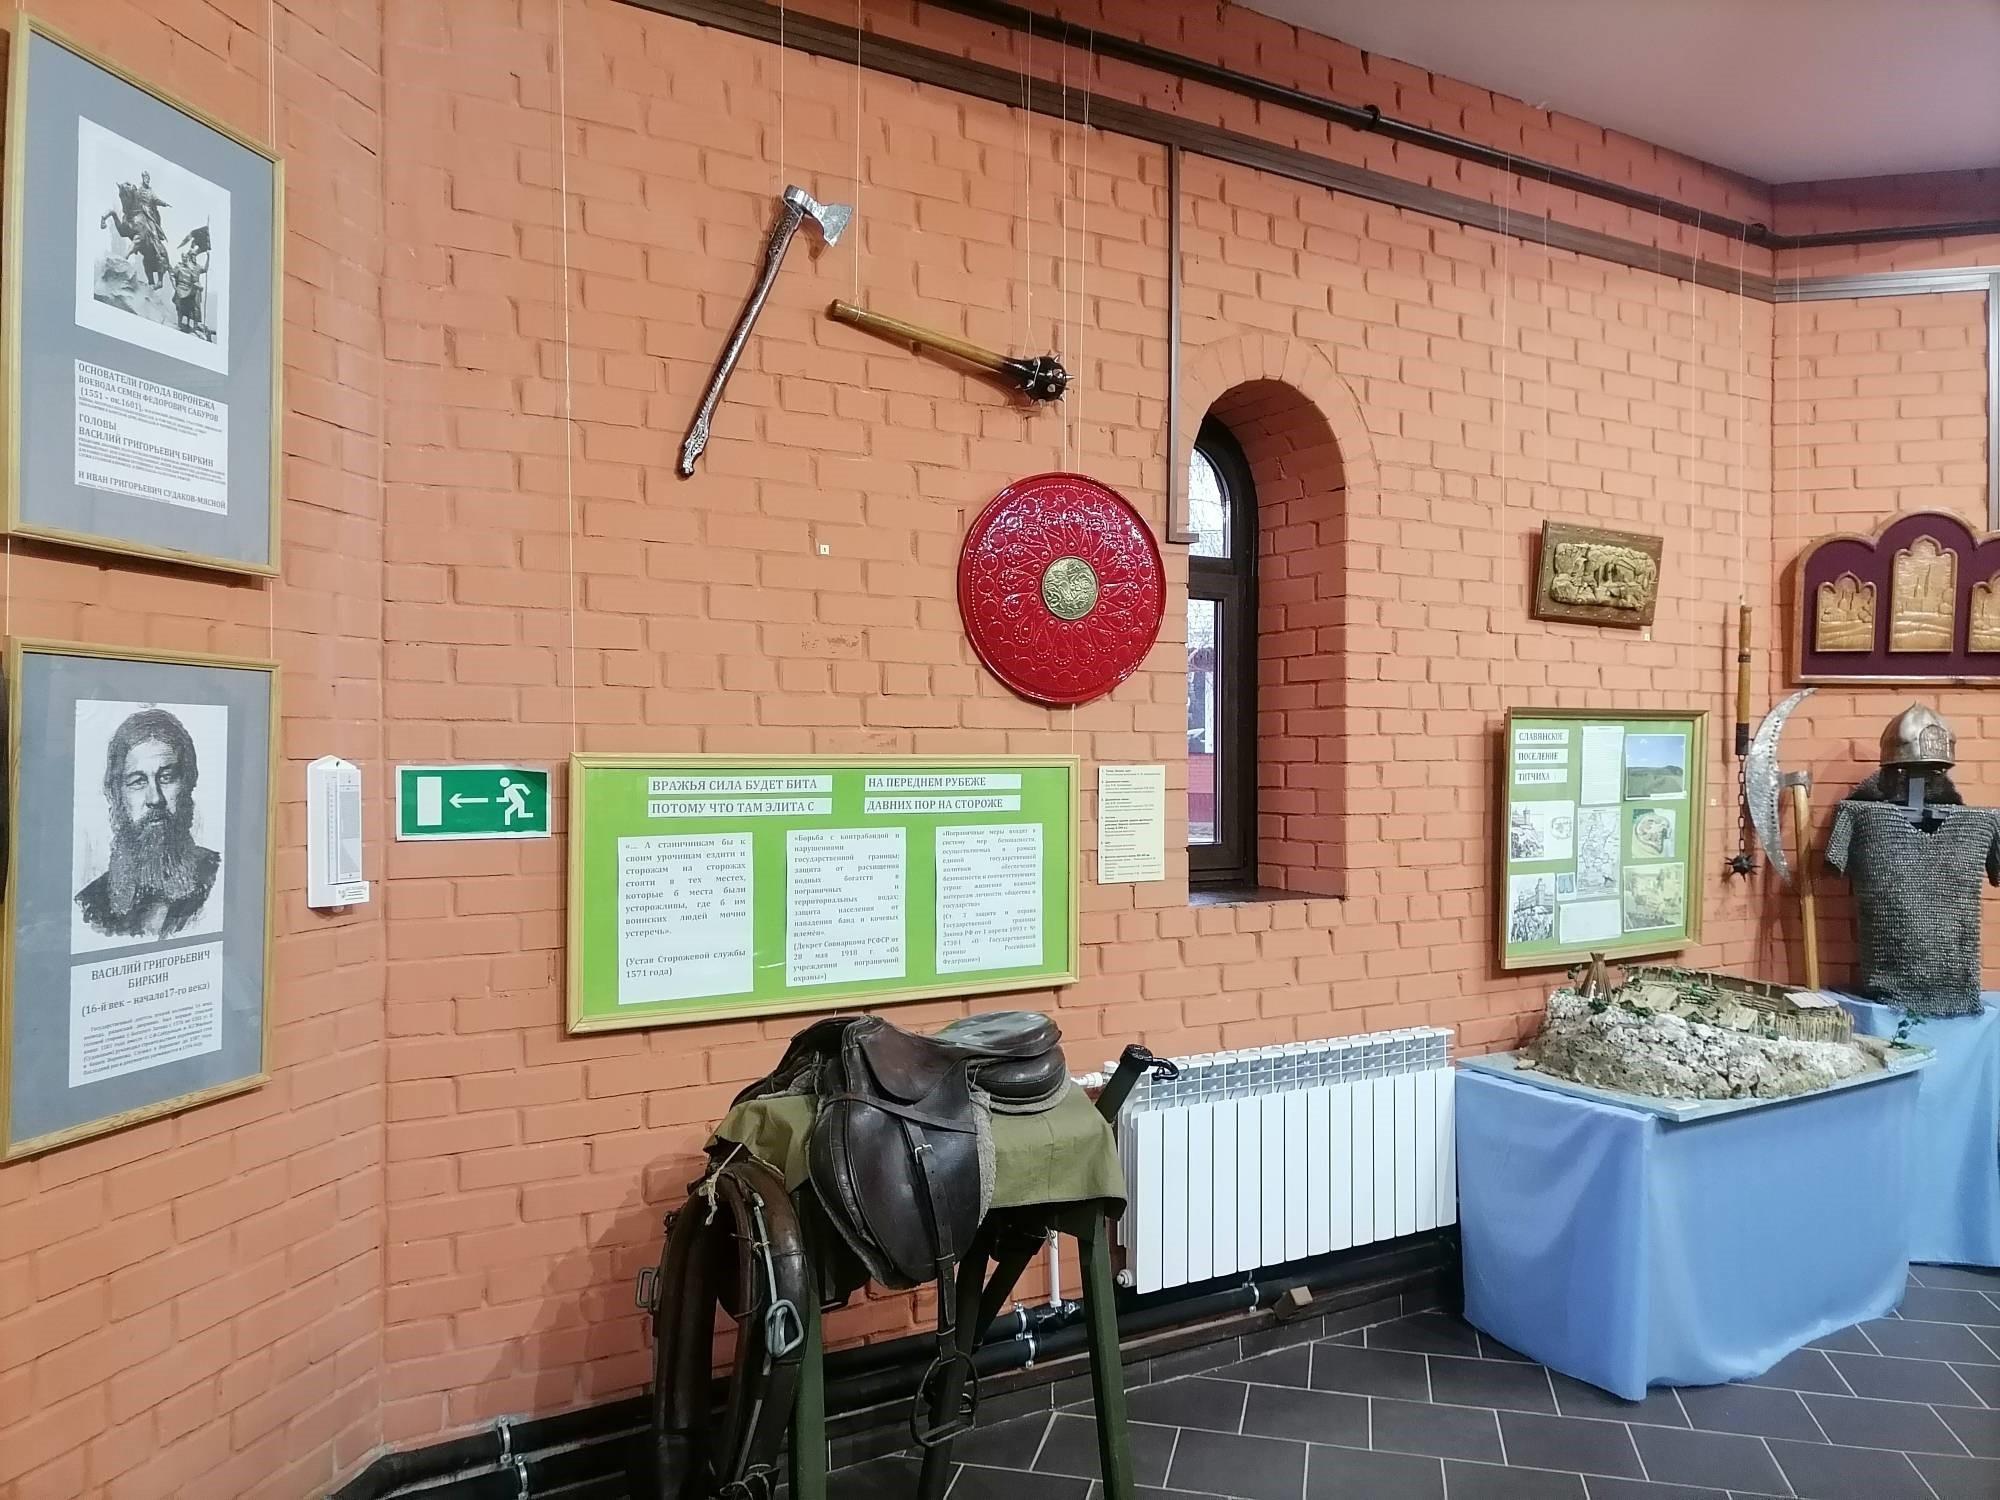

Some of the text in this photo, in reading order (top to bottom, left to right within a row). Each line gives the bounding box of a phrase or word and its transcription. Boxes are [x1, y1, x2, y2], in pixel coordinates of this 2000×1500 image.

[79, 363, 215, 411] ОСНОВАТЕЛИ ГОРОДА ВОРОНЕЖА
[79, 375, 116, 392] ВОЕВОДА
[117, 386, 142, 400] СЕМЕН
[142, 393, 186, 413] ФЕДОРОВИЧ
[188, 407, 219, 422] САБУРОВ
[80, 387, 103, 400] (1551
[79, 414, 117, 430] ГОЛОВЫ
[79, 426, 121, 445] ВАСИЛИЙ
[123, 437, 180, 458] ГРИГОРЬЕВИЧ
[182, 454, 214, 467] БИРКИН
[86, 472, 108, 484] ИВАН
[110, 477, 162, 495] ГРИГОРЬЕВИЧ
[163, 490, 226, 510] СУДАКОВ-МЯСНОЙ
[1519, 732, 1563, 741] СЛАВЯНСКОЕ
[1519, 752, 1559, 761] ПОСЕЛЕНИЕ
[868, 777, 986, 788] НА ПЕРЕДНЕМ РУБЕЖЕ
[1518, 772, 1550, 781] ТИТЧИХА
[653, 779, 817, 791] ВРАЖЬЯ СИЛА БУДЕТ БИТА
[652, 802, 814, 814] ПОТОМУ ЧТО ТАМ ЭЛИТА С
[867, 799, 1003, 812] ДАВНИХ ПОР НА СТОРОЖЕ
[721, 838, 733, 846] бы
[626, 867, 668, 876] сторожам
[706, 863, 746, 871] сторожах
[626, 892, 664, 900] которые
[697, 901, 711, 909] где
[625, 917, 667, 925] воинских
[680, 913, 707, 921] людей
[868, 937, 890, 945] РСФСР
[626, 949, 746, 967] (Устав Сторожевой службы
[92, 950, 211, 980] ВАСИЛИЙ ГРИГОРЬЕВИЧ
[627, 967, 672, 978] 1571 года)
[128, 972, 169, 989] БИРКИН
[82, 1003, 107, 1017] (16-й
[109, 999, 125, 1008] век
[188, 982, 210, 994] века)
